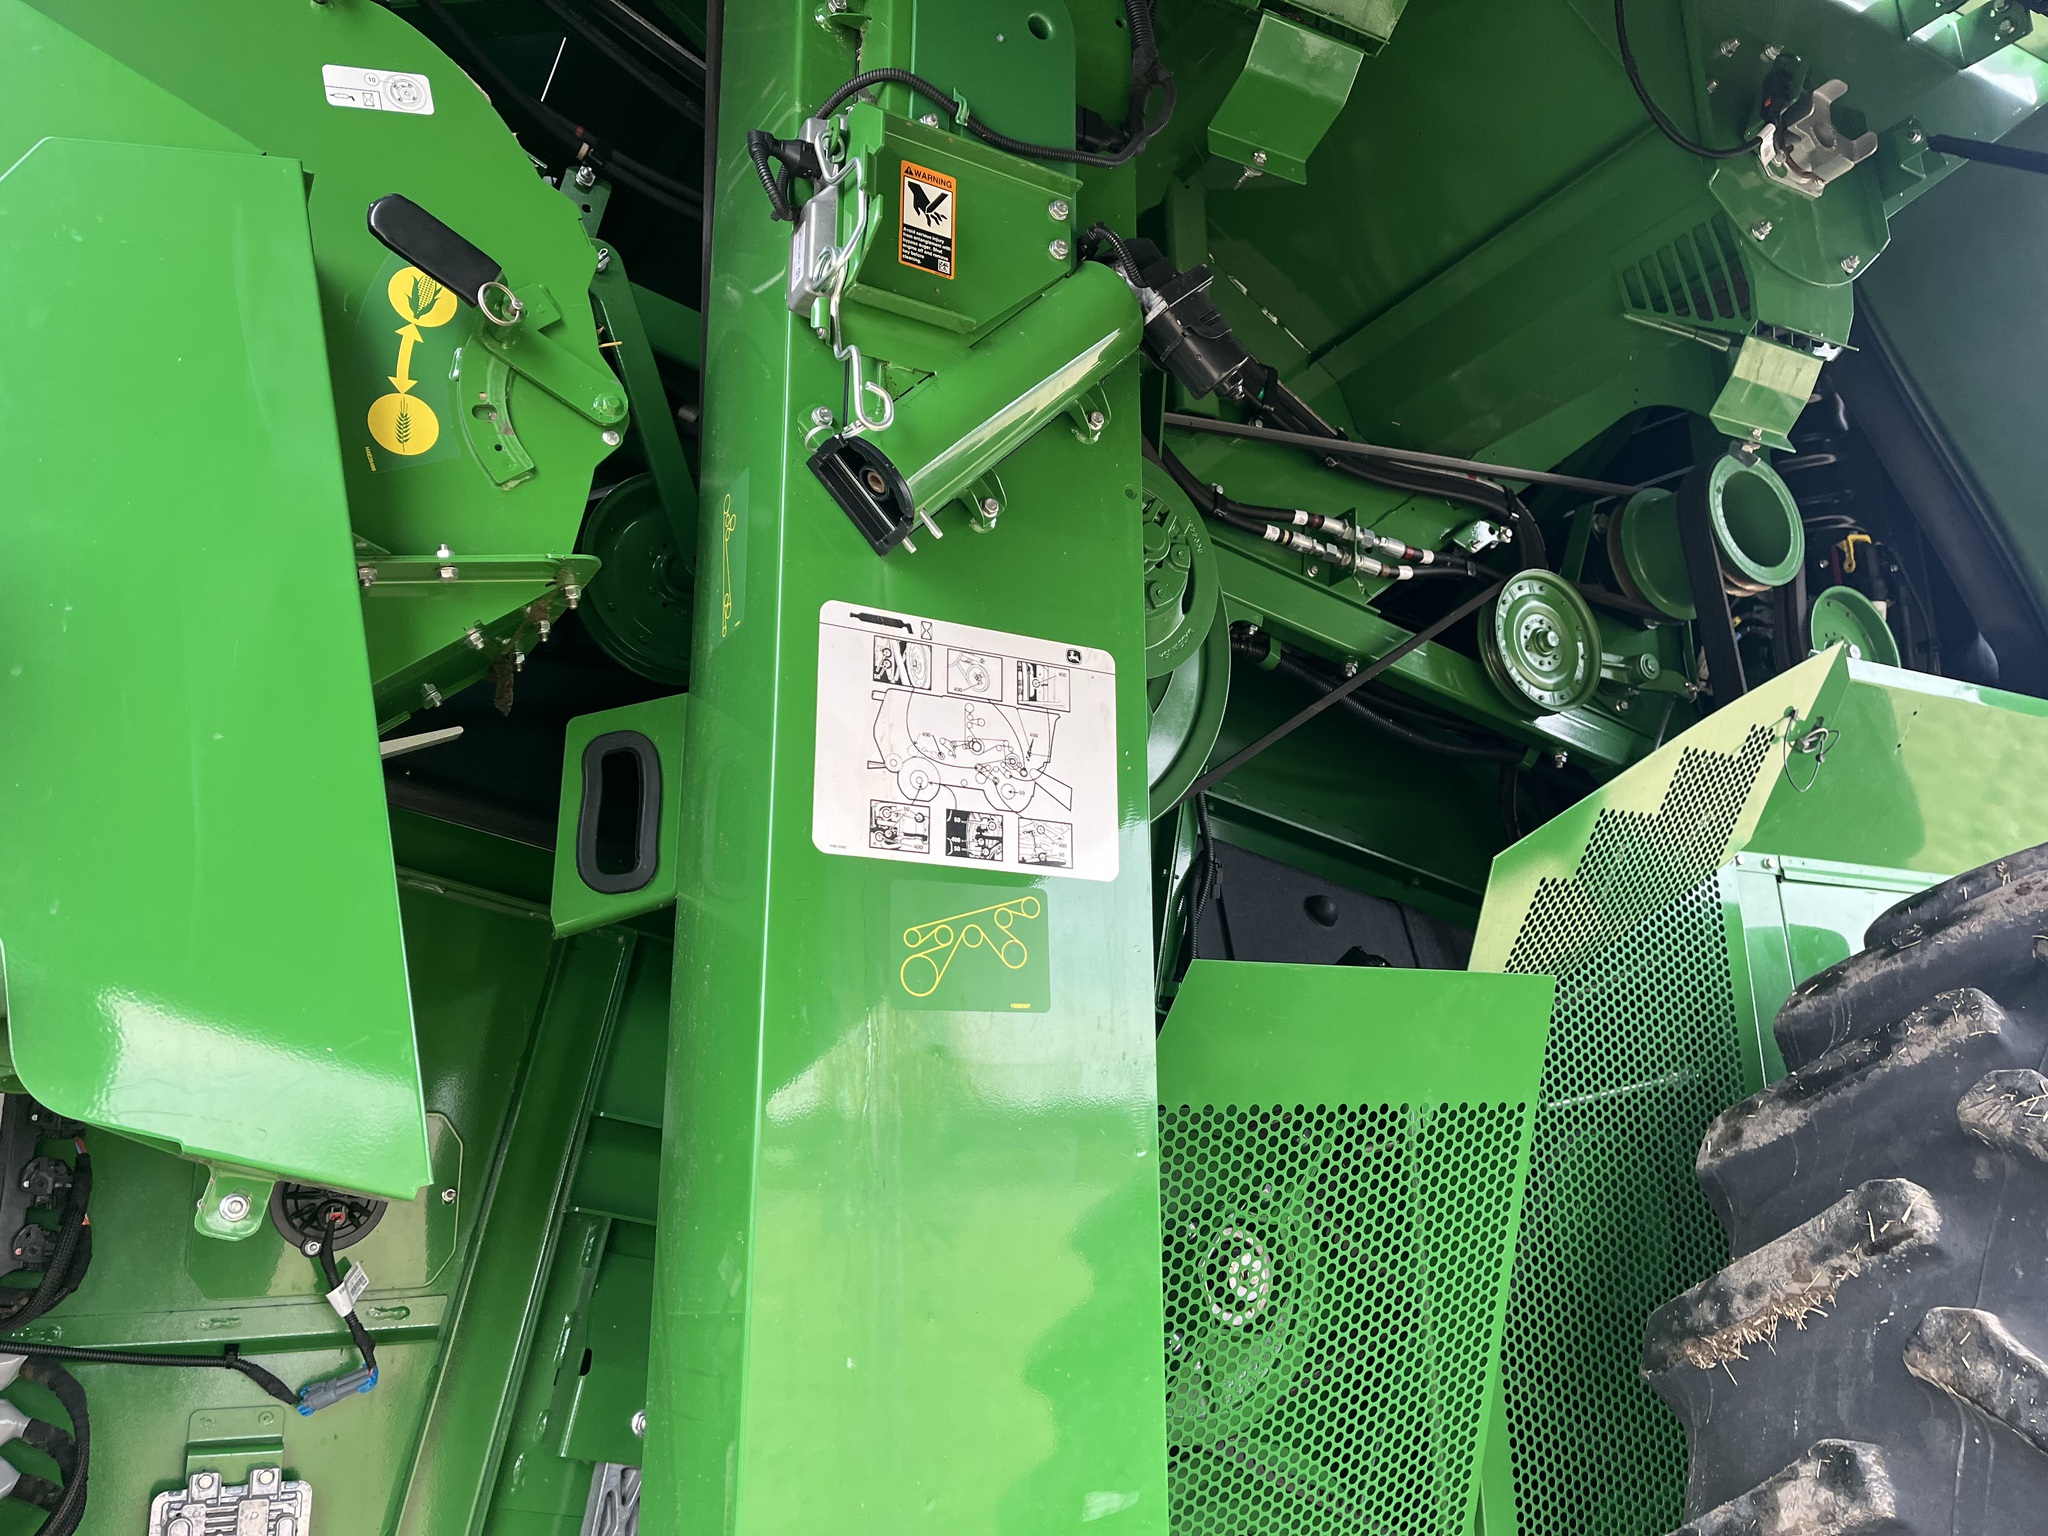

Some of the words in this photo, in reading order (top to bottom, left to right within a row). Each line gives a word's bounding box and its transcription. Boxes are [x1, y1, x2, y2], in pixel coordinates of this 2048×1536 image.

[914, 168, 952, 189] WARNING
[903, 227, 916, 235] Avoid
[916, 231, 932, 240] serious
[932, 236, 945, 245] injury
[914, 236, 942, 248] entanglement
[903, 237, 918, 246] bypass
[933, 247, 943, 255] Shut
[903, 243, 917, 251] engine
[933, 253, 949, 261] remove
[910, 251, 925, 259] before
